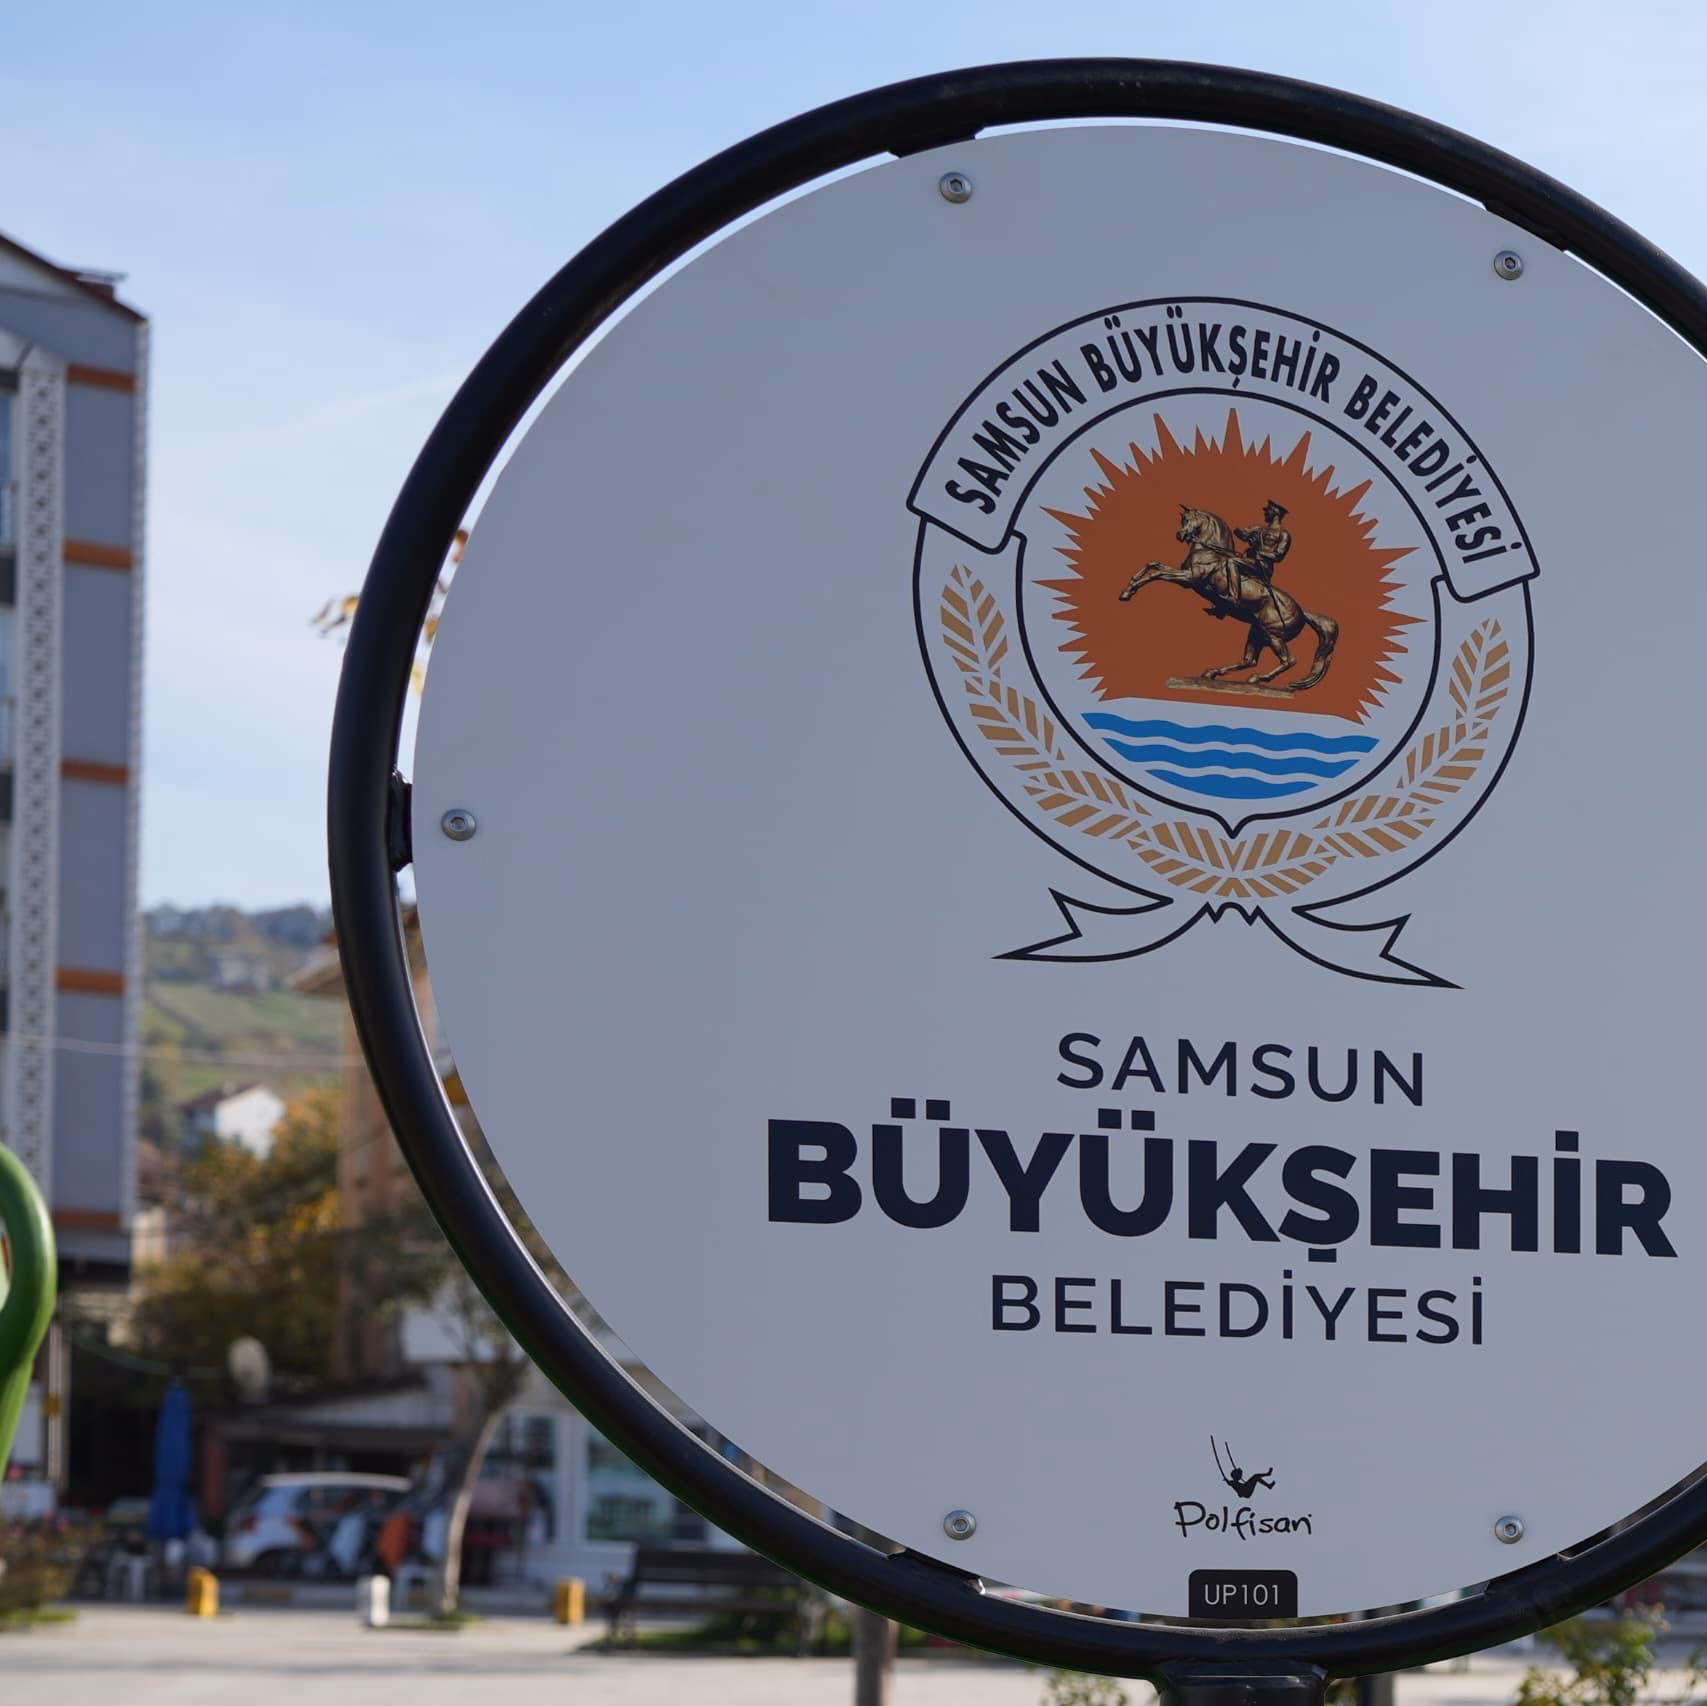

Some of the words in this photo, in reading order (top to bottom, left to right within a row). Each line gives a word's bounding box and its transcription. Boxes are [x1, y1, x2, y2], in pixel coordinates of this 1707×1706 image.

[945, 359, 1087, 514] SAMSUN
[1080, 305, 1340, 404] BÜYÜKŞEHİR
[1343, 374, 1522, 564] BELEDİYESİ
[1057, 1033, 1425, 1107] SAMSUN
[768, 1097, 1678, 1262] BÜYÜKŞEHİR
[991, 1269, 1484, 1345] BELEDİYESİ
[1174, 1501, 1312, 1541] Polfisan
[1204, 1583, 1279, 1606] UP101
